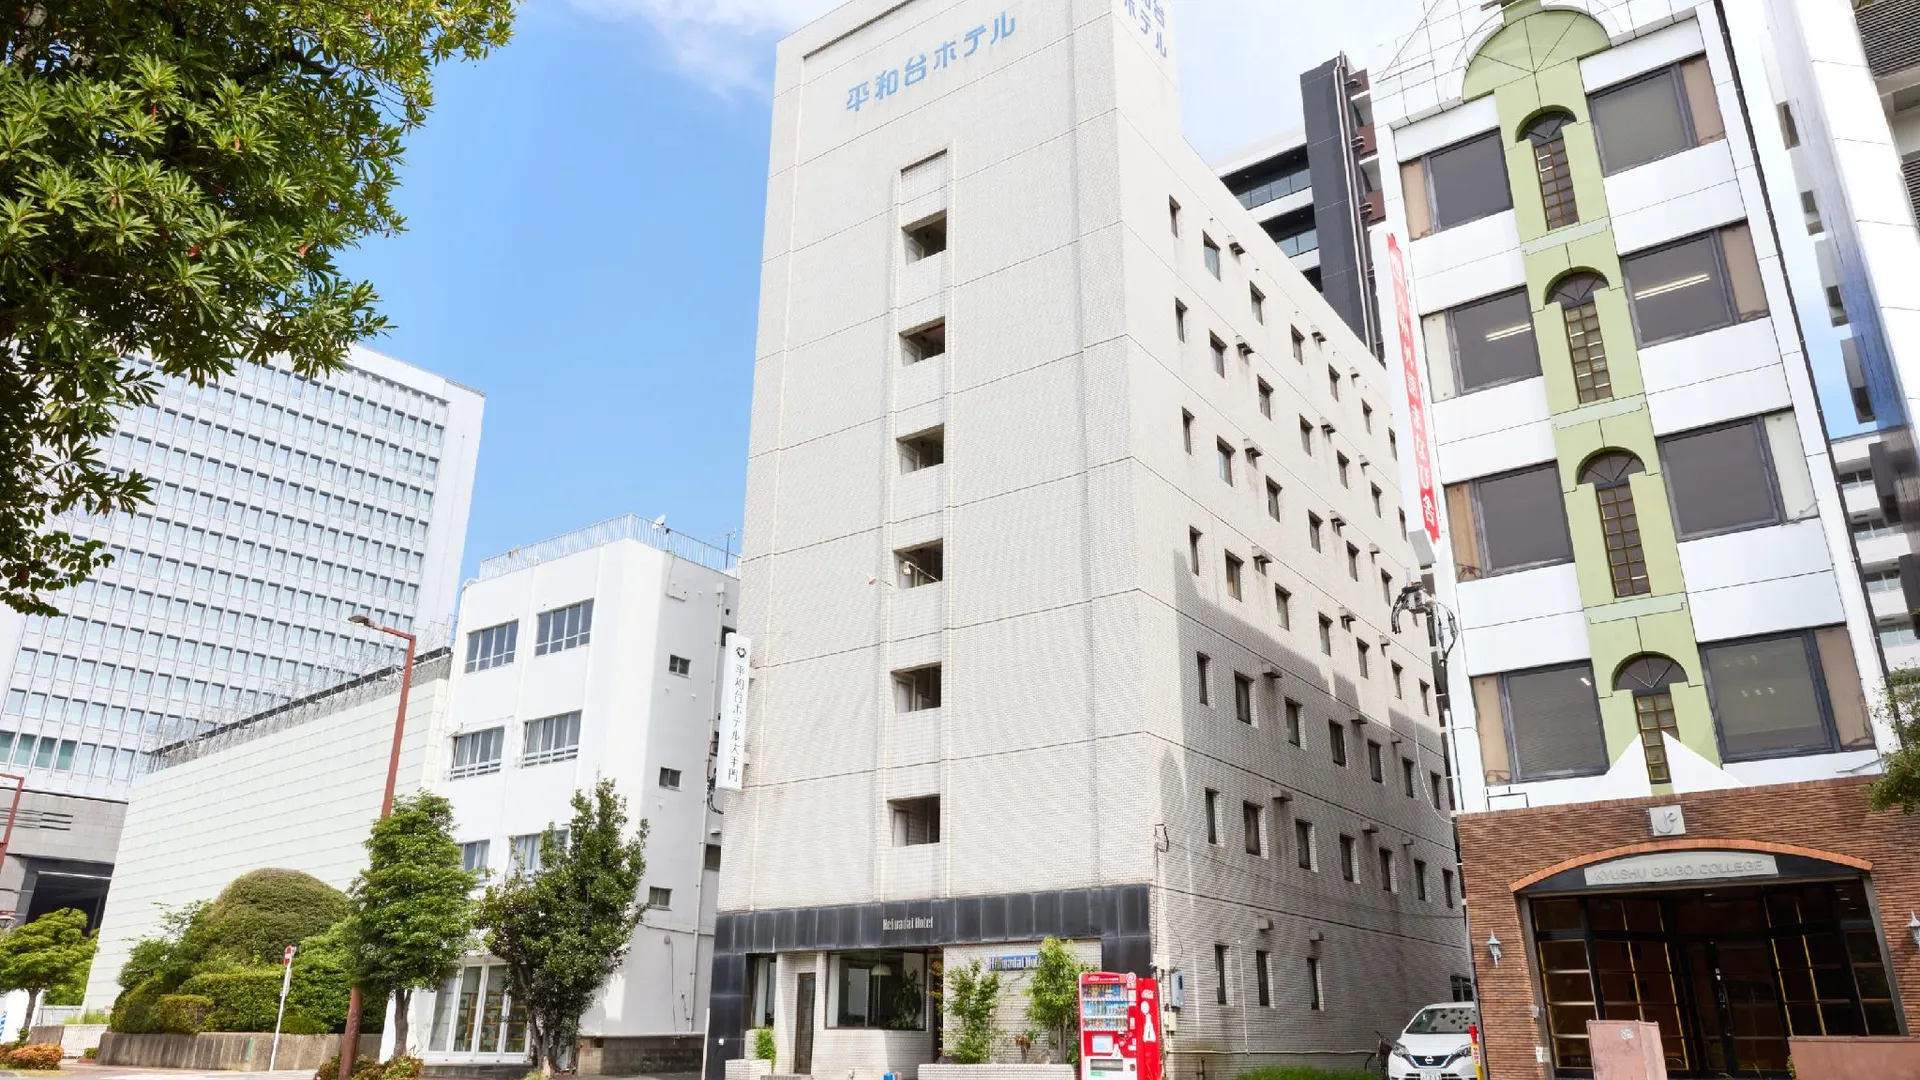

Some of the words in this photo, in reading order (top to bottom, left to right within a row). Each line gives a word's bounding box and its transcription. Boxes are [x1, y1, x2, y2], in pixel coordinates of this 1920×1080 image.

[846, 11, 1016, 112] 平和台ホテル
[728, 664, 745, 783] 平和台ホテル大手門
[1595, 867, 1648, 881] KYUSHU
[1651, 865, 1694, 878] GAIGO
[1699, 860, 1764, 875] COLLEGE
[915, 916, 933, 929] Hotel
